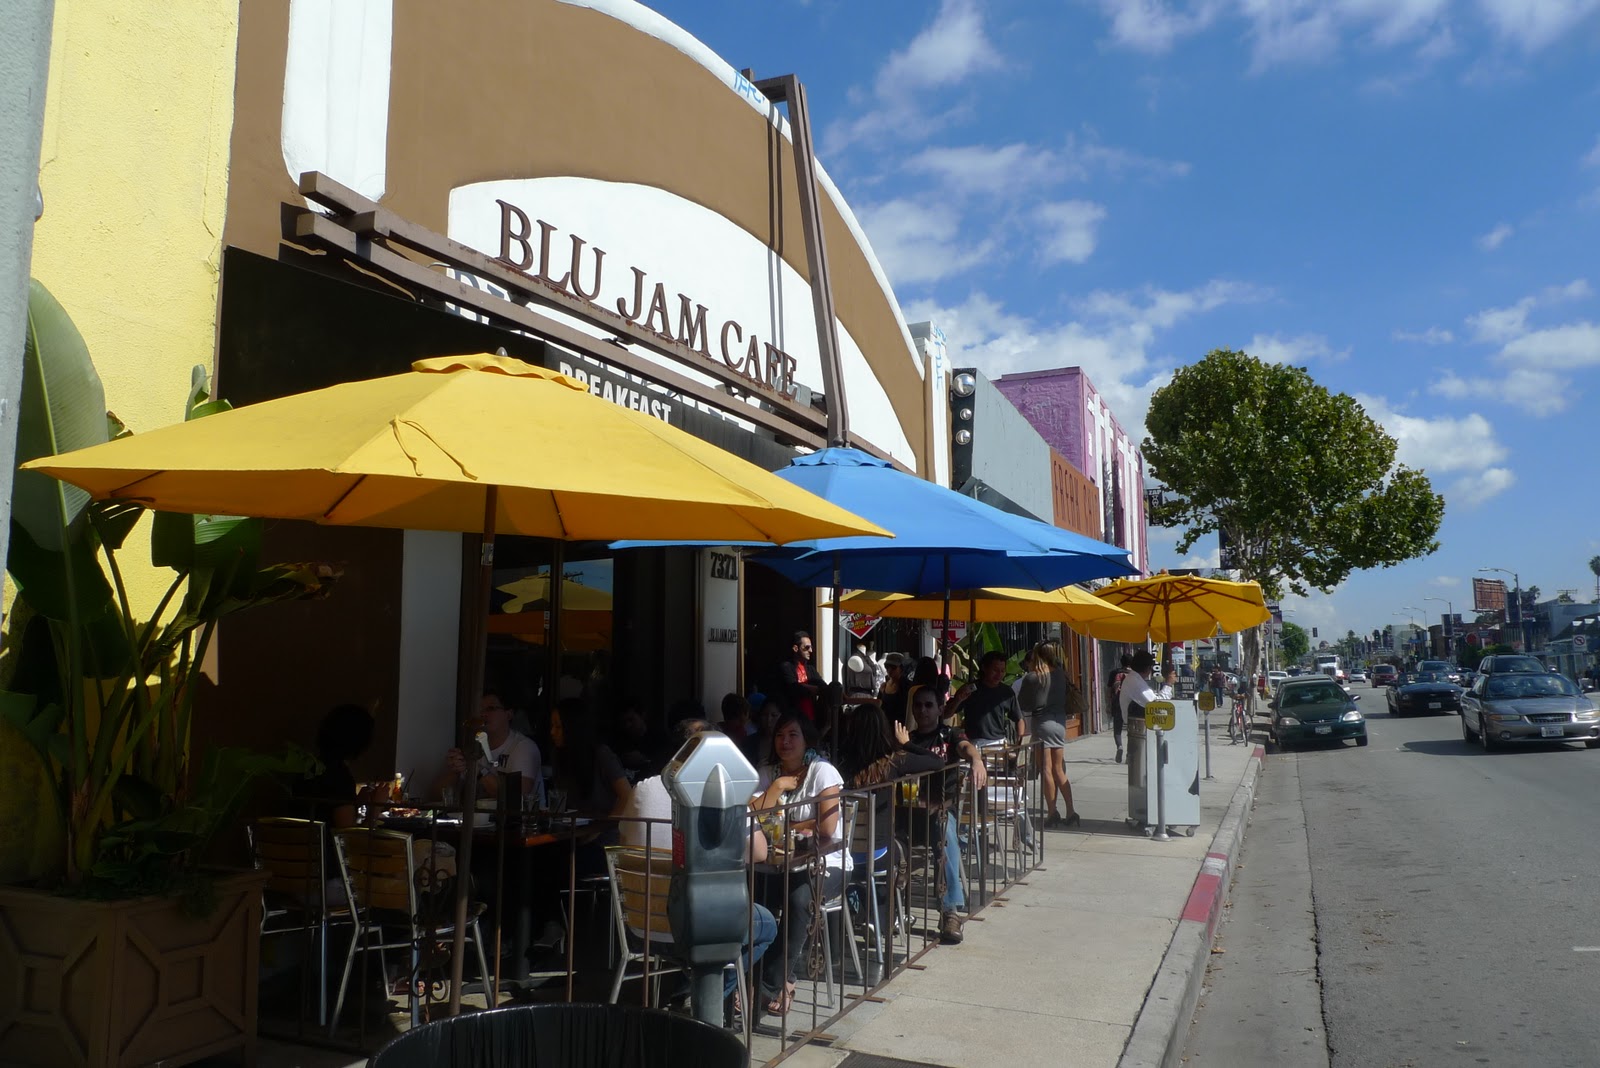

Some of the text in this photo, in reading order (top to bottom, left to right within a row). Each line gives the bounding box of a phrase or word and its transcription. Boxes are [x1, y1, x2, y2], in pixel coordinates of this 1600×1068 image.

[494, 199, 797, 399] BLU JAM CAFE
[710, 551, 738, 581] 7371
[933, 620, 964, 628] MAHINE
[1151, 715, 1168, 725] ONLY
